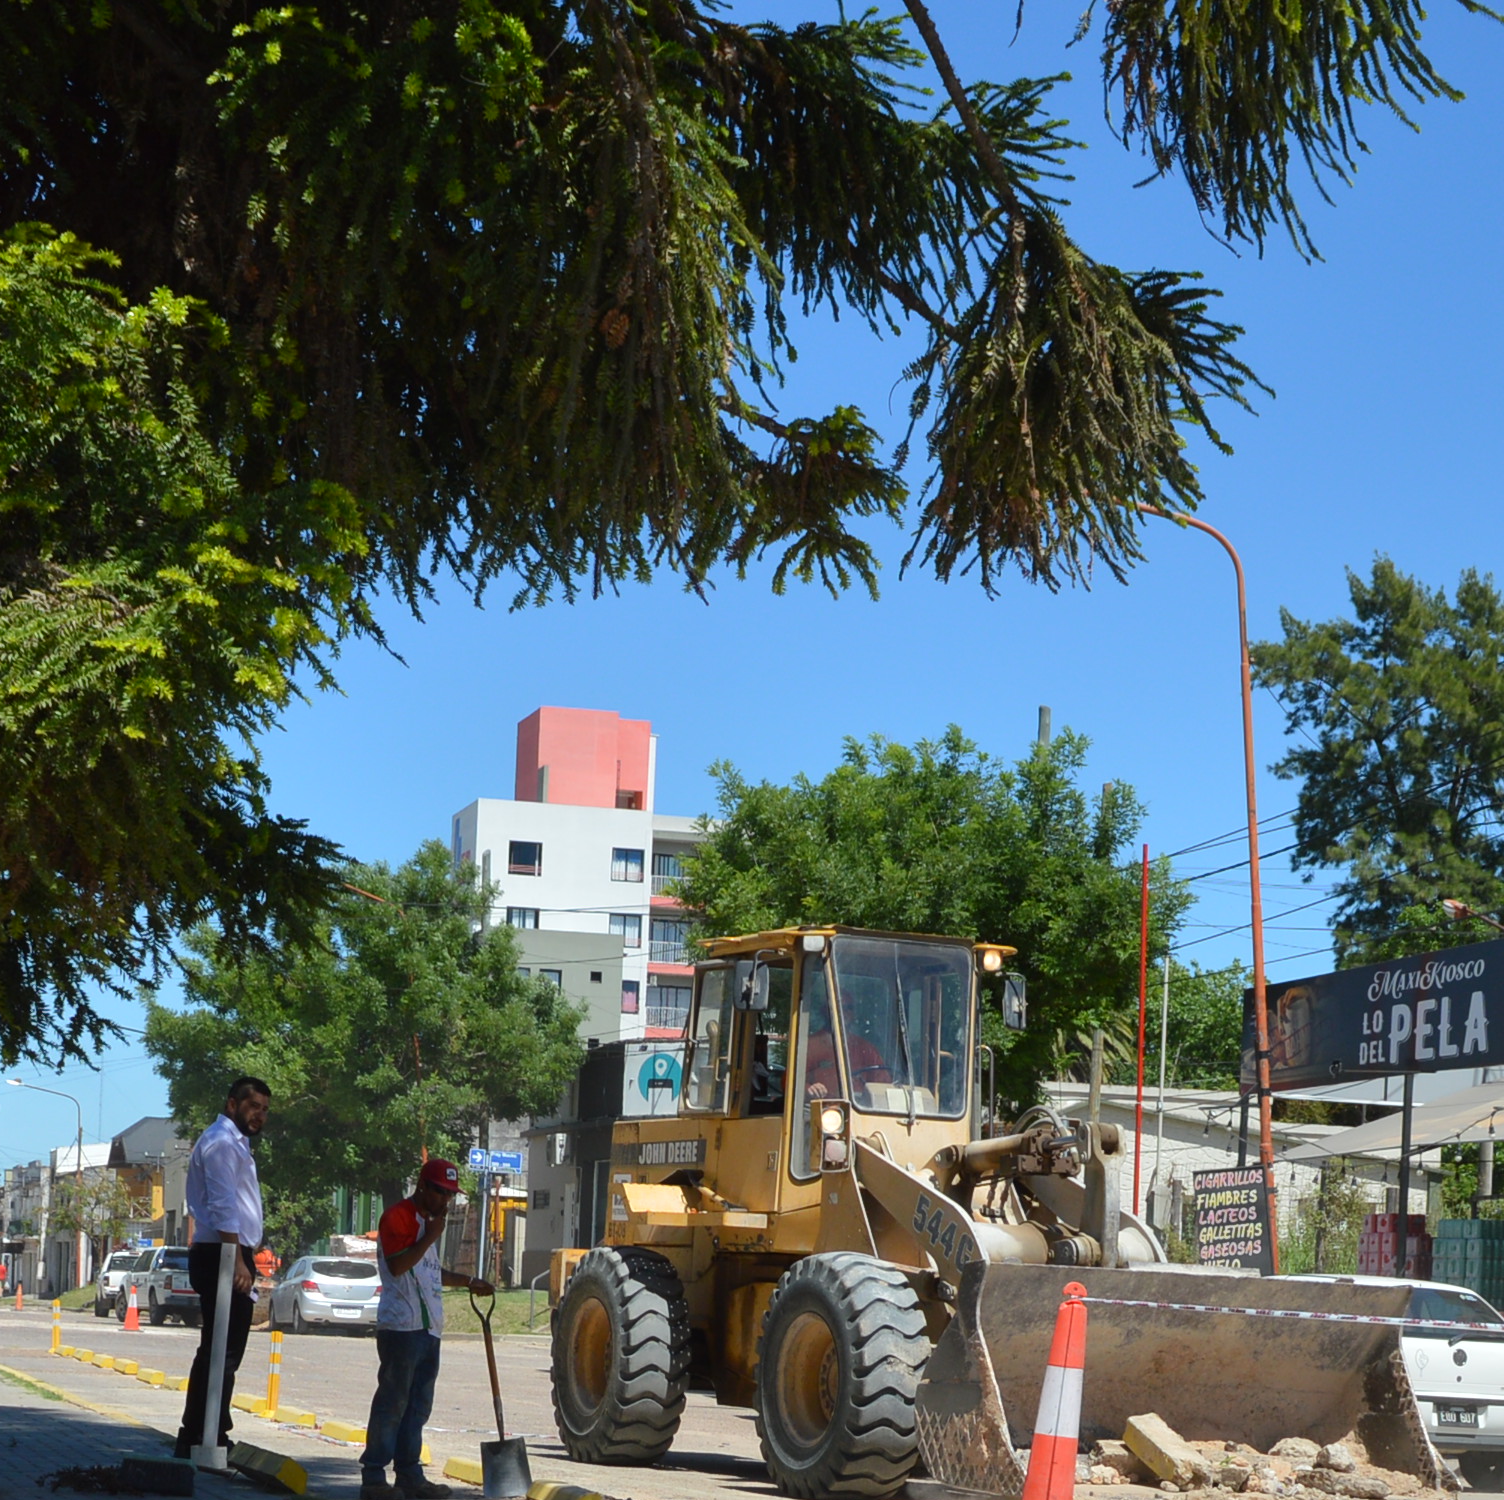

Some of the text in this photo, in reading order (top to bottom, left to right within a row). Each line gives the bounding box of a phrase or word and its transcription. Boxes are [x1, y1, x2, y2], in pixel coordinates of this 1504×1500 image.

[1362, 1010, 1384, 1035] LO
[1388, 990, 1489, 1065] PELA
[1359, 1040, 1385, 1065] DEL
[638, 1141, 698, 1165] JOHN DEERE
[1194, 1169, 1263, 1190] CIGARRILLOS
[1196, 1189, 1258, 1210] FIAMBRES
[1199, 1206, 1257, 1225] LACTEOS
[912, 1191, 975, 1273] 544G
[1199, 1222, 1263, 1244] GALLETITAS
[1200, 1239, 1262, 1260] GASEOSAS
